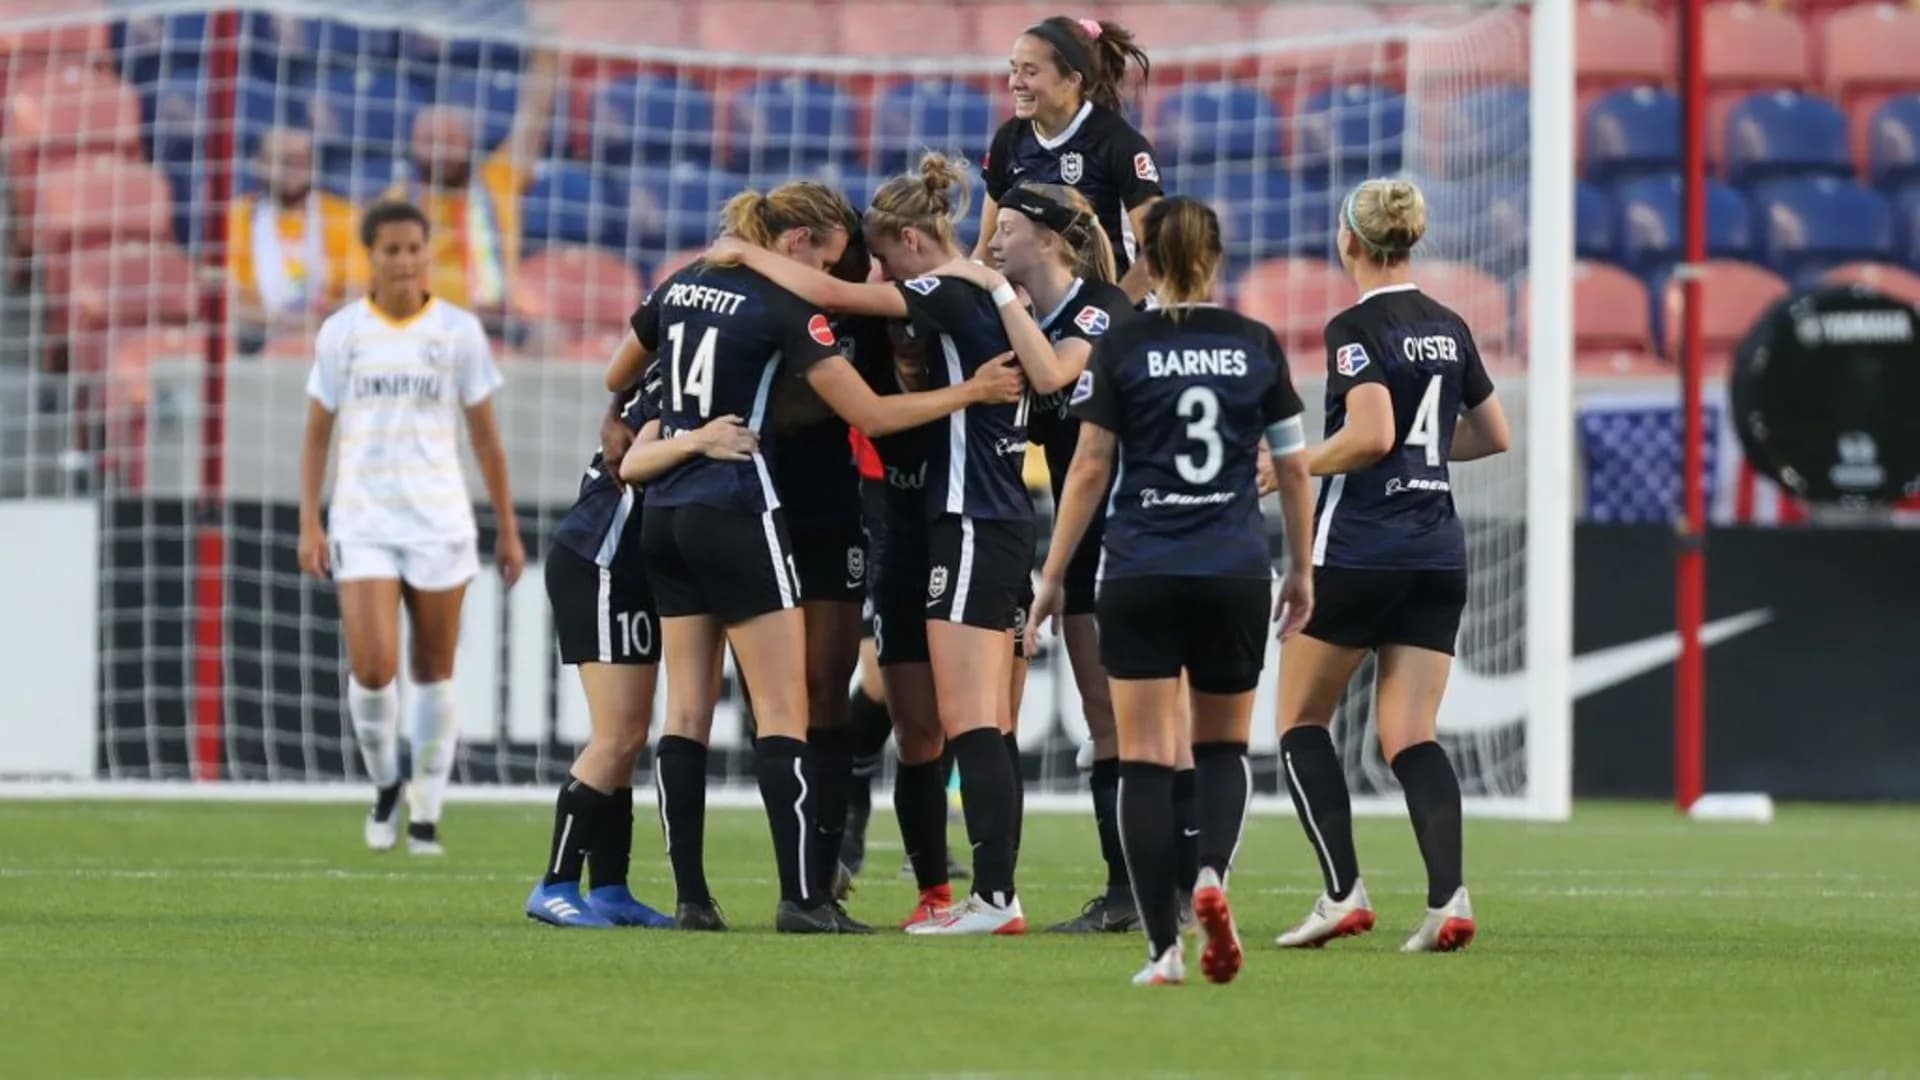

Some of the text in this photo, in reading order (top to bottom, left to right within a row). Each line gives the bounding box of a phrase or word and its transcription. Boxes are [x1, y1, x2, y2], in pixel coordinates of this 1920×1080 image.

[663, 283, 747, 316] PROFFITT
[667, 320, 719, 418] 14
[1147, 349, 1248, 377] BARNES
[1403, 335, 1458, 362] OYSTER
[1174, 385, 1224, 485] 3
[1404, 374, 1443, 467] 4
[616, 610, 652, 656] 10
